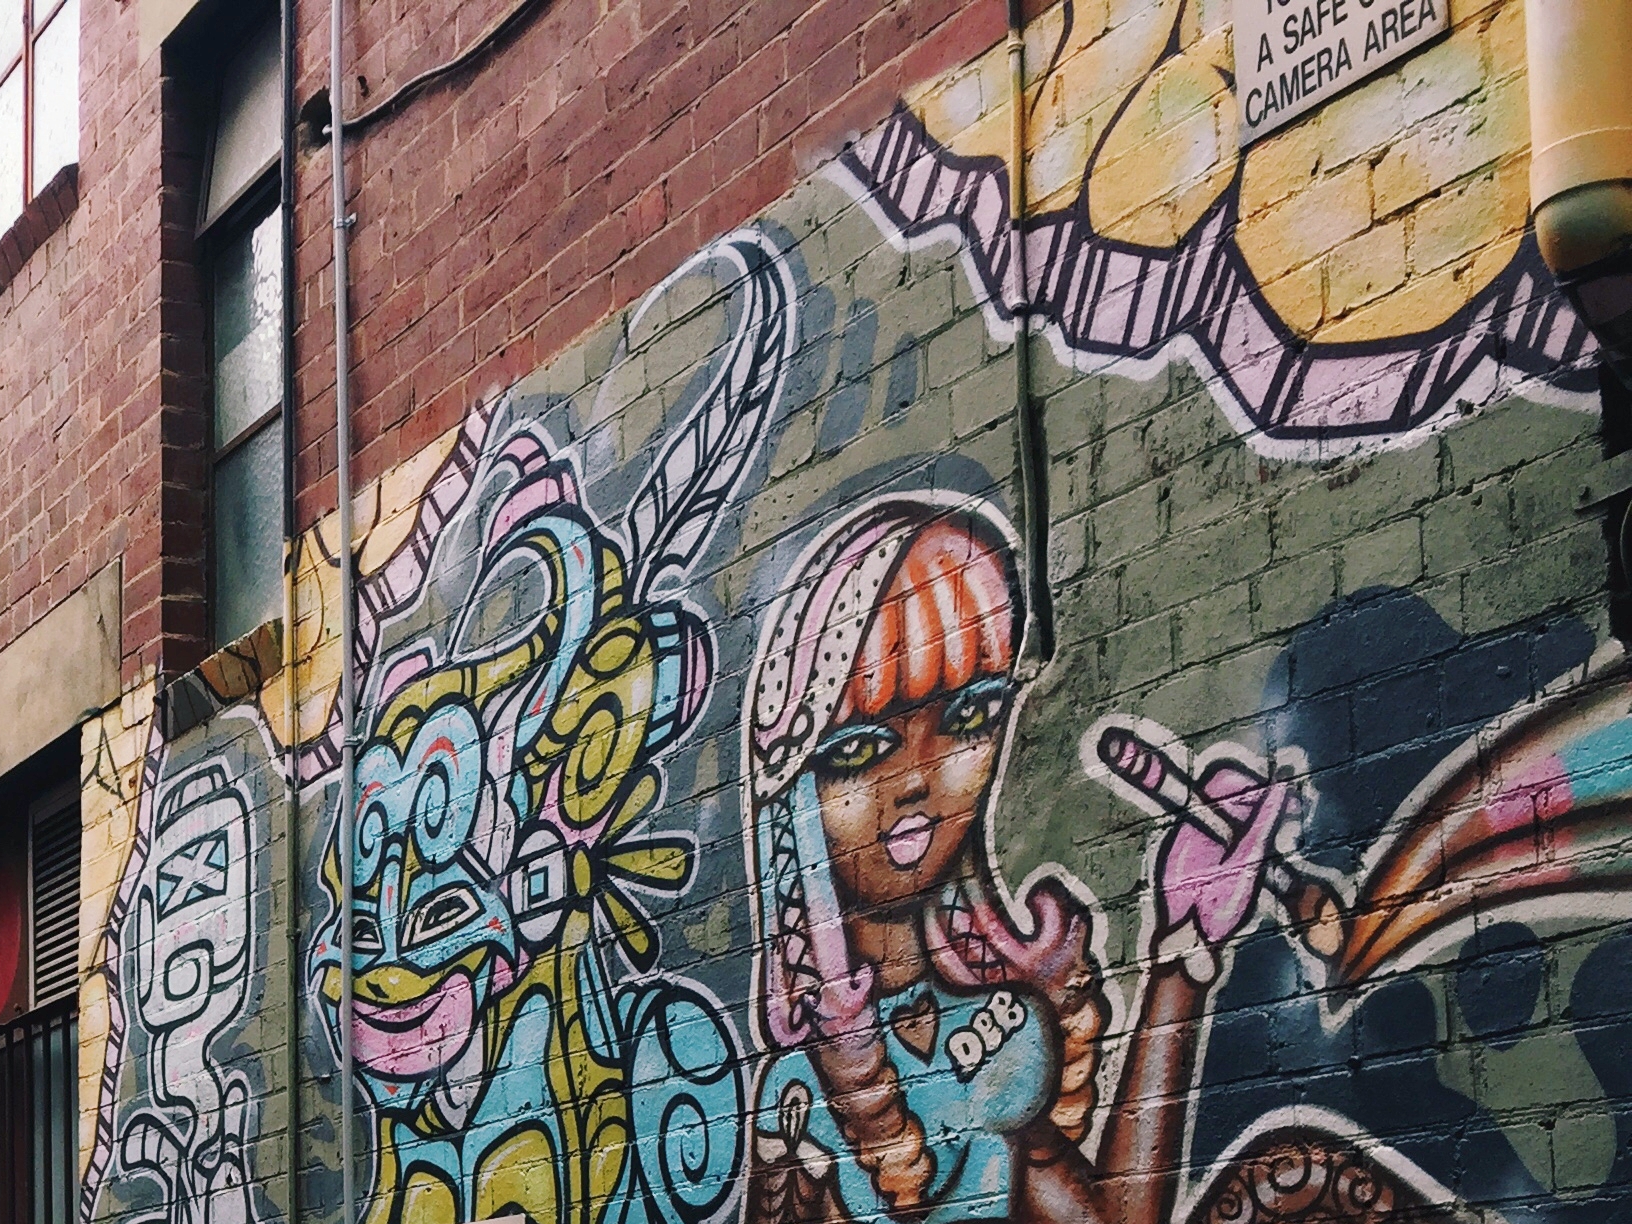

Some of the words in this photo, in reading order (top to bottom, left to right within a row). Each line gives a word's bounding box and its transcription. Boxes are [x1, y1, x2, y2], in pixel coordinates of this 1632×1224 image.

[1245, 37, 1353, 128] CAMERA
[1363, 0, 1437, 62] AREA
[1257, 33, 1274, 73] A
[1283, 0, 1348, 54] SAFE
